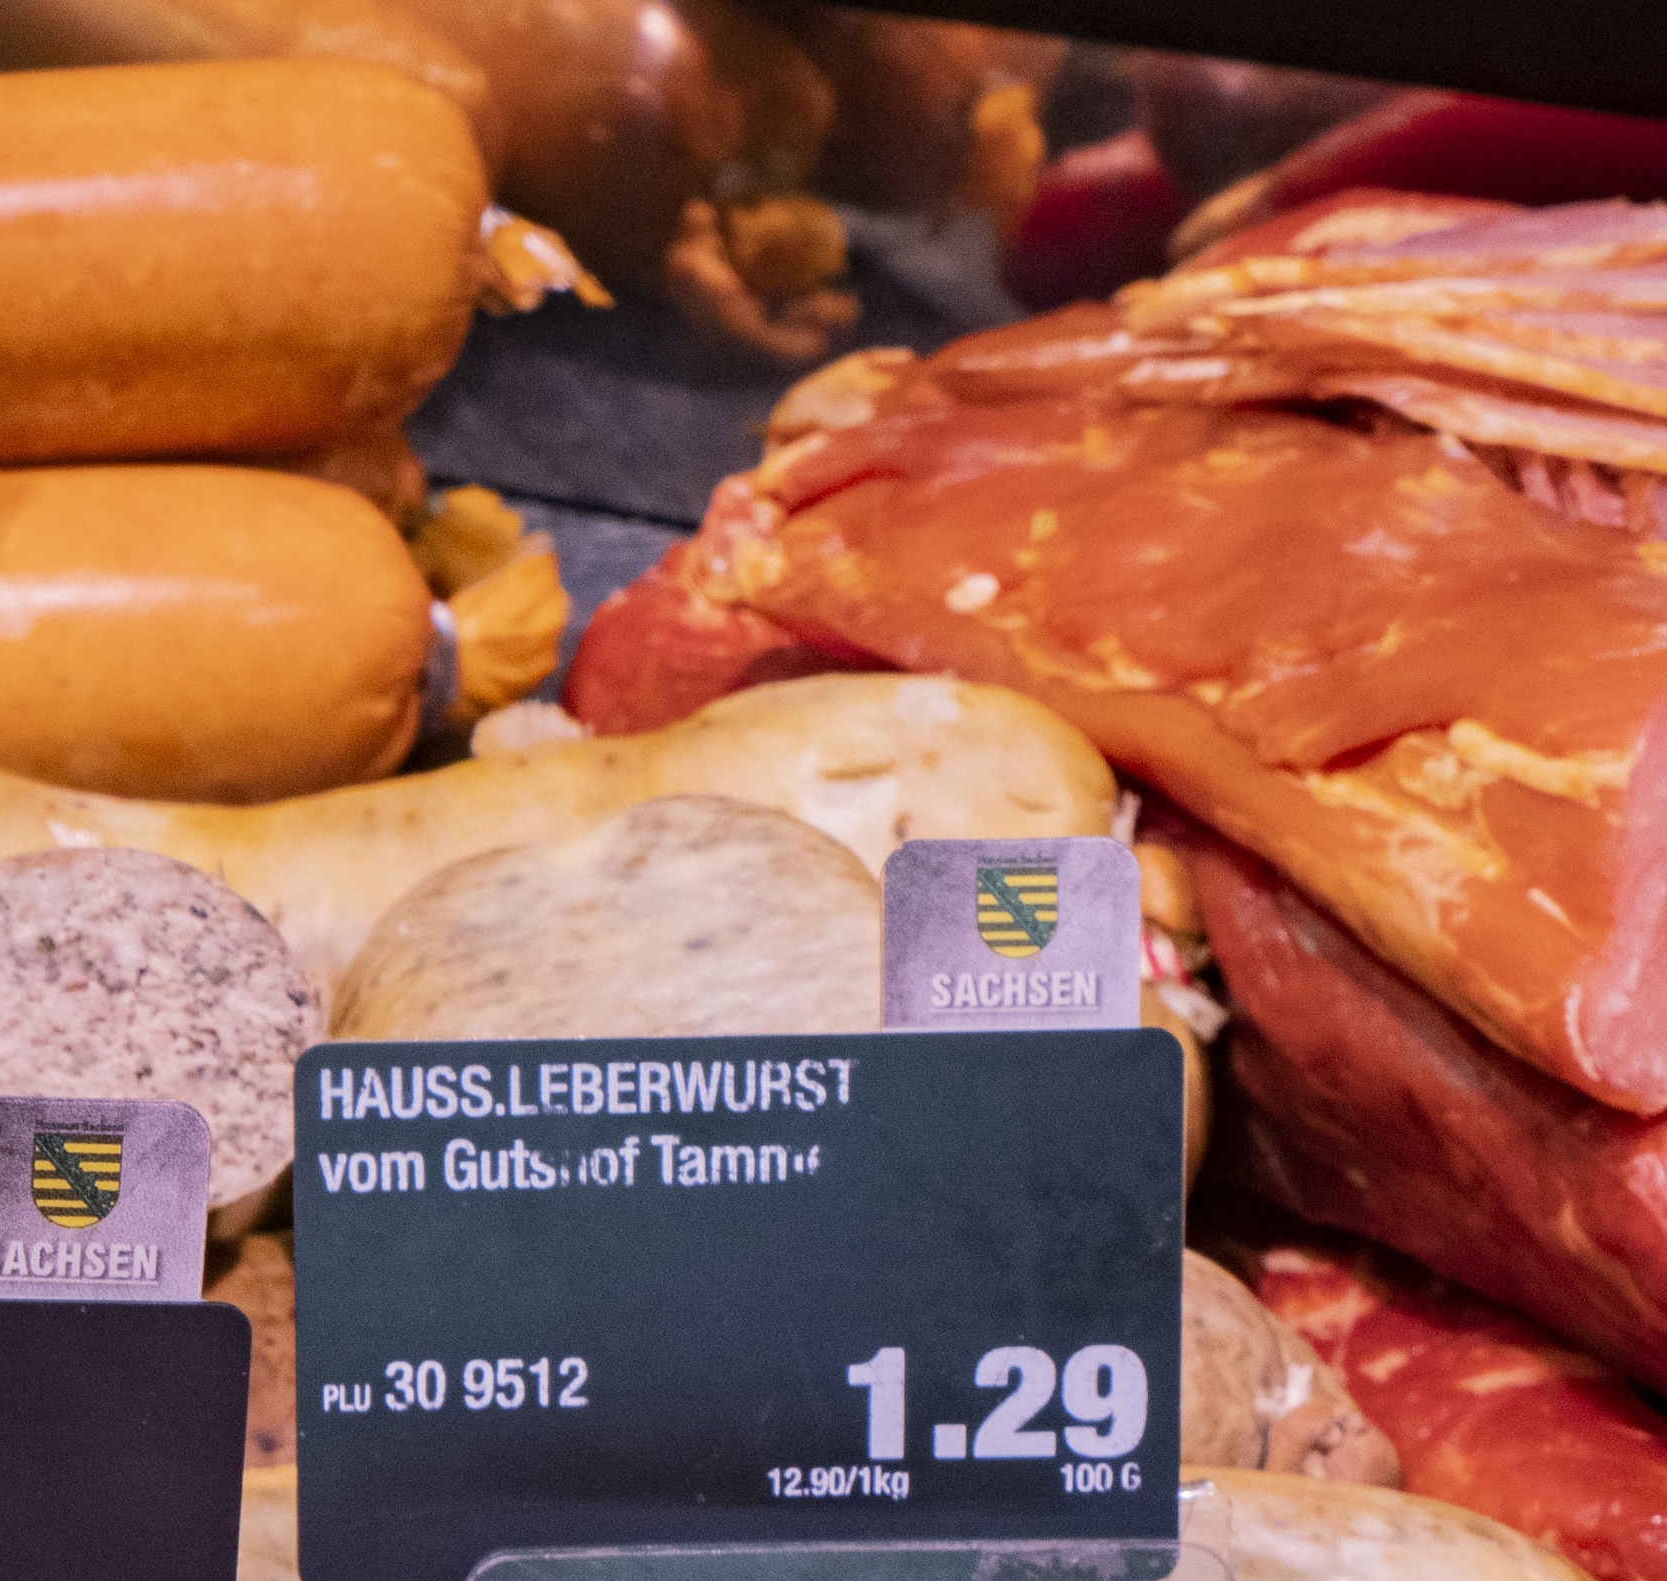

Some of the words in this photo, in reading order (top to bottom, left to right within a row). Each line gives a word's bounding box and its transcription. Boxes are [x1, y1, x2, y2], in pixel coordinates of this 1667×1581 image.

[930, 971, 1097, 1009] SACHSEN
[320, 1058, 857, 1120] HAUSS.LEBERWURST
[318, 1152, 426, 1193] vom
[323, 1383, 372, 1412] PLU
[384, 1360, 447, 1411] 30
[462, 1356, 589, 1409] 9512
[847, 1343, 1149, 1461] 1.29
[767, 1465, 910, 1500] 12.90/1kg
[1061, 1462, 1114, 1493] 100
[1120, 1461, 1142, 1491] G
